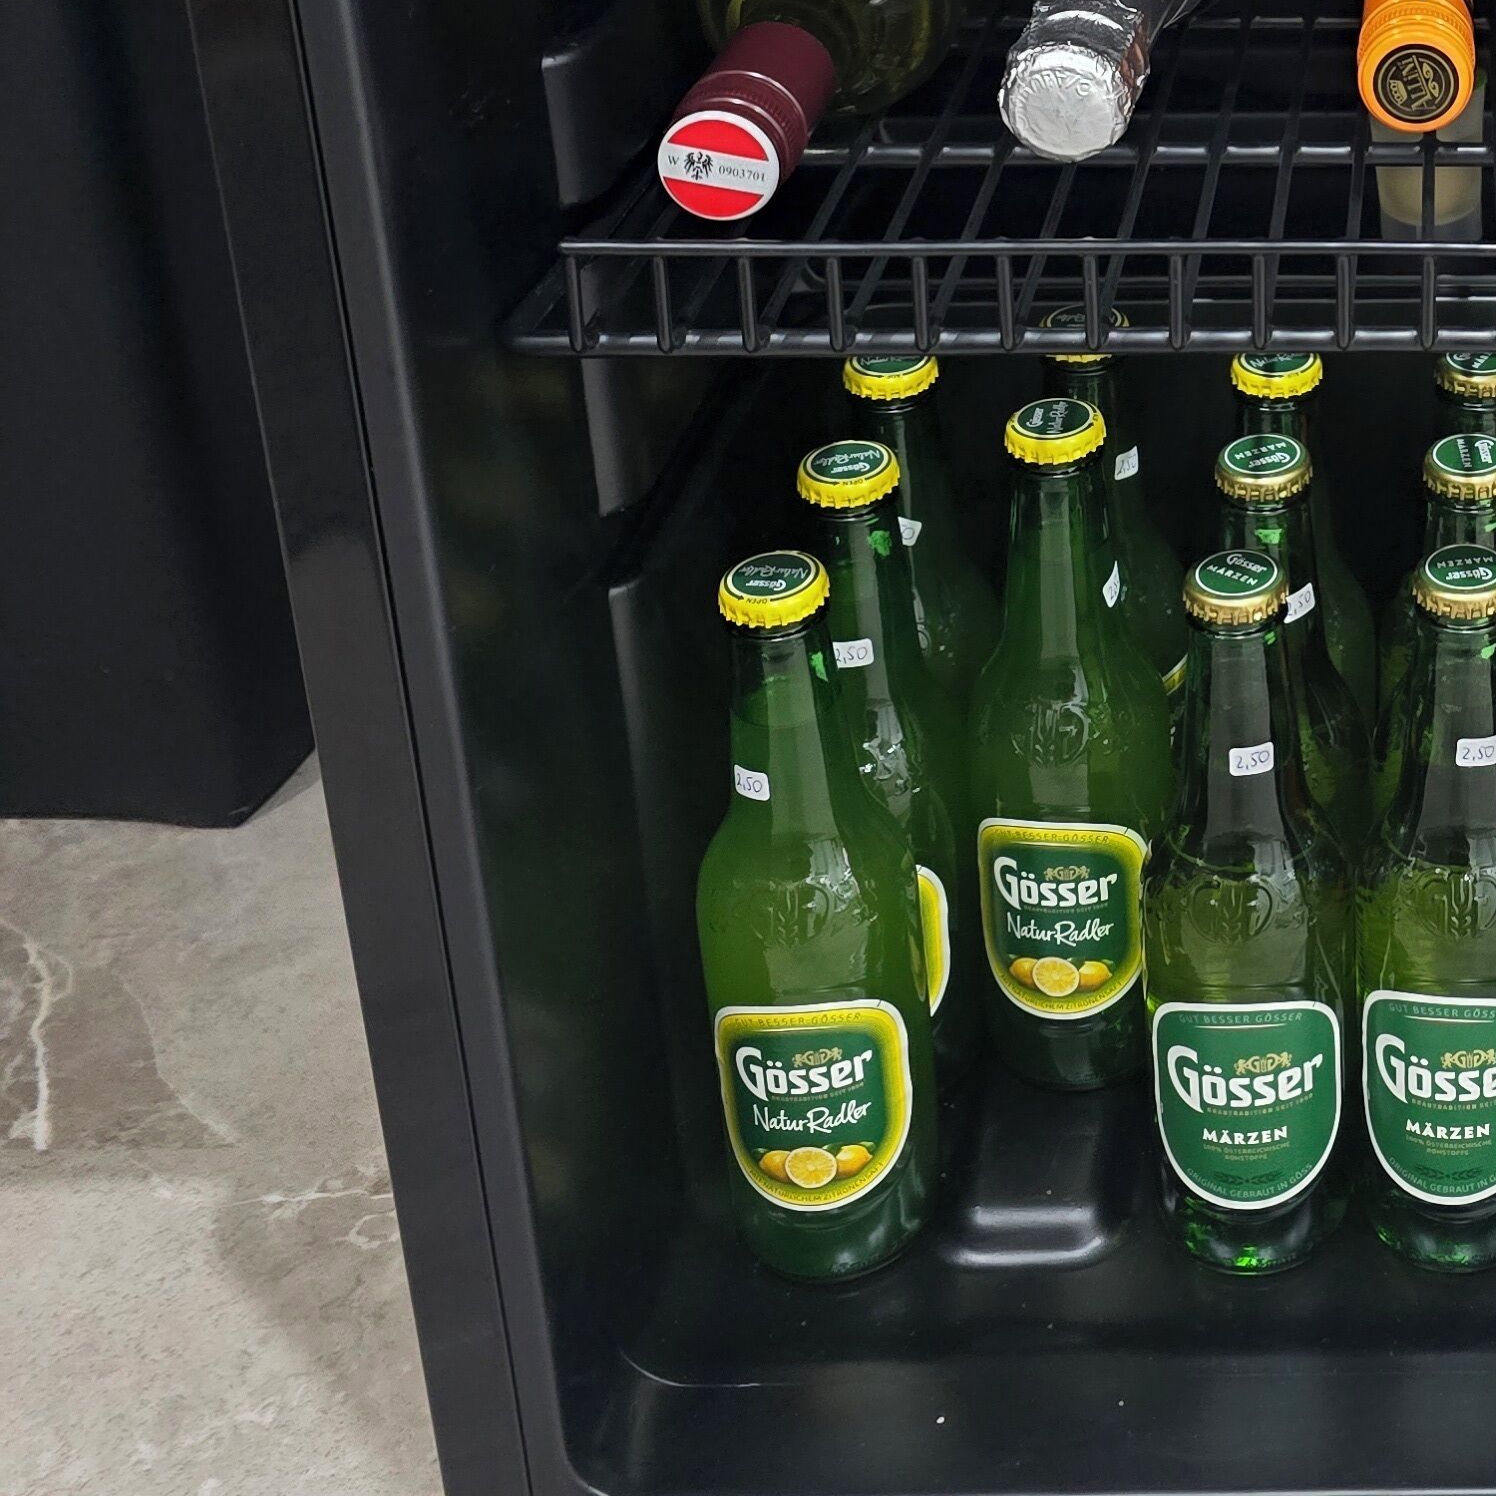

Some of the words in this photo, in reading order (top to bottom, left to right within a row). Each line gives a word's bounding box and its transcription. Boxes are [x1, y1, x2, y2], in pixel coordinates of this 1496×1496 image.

[667, 153, 681, 167] W
[717, 164, 767, 183] 0903701
[830, 461, 871, 476] Gösser
[1225, 552, 1268, 575] Gösser
[1443, 565, 1494, 581] Gösser
[745, 577, 788, 591] Gösser
[1233, 748, 1272, 772] 2,50
[1462, 743, 1496, 762] 2,50
[993, 856, 1118, 911] Gösser
[1006, 911, 1115, 947] NaturRadler
[1203, 1014, 1251, 1025] BESSER
[1255, 1011, 1304, 1024] GÖSSER
[1412, 1005, 1459, 1018] BESSER
[735, 1045, 873, 1102] Gösser
[1167, 1044, 1323, 1114] Gösser
[752, 1099, 873, 1134] NaturRadler
[1202, 1125, 1289, 1146] MÄRZEN
[1405, 1118, 1491, 1141] MÄRZEN
[1186, 1166, 1228, 1196] ORIGINAL
[1229, 1186, 1278, 1199] GEBRAUT
[1277, 1180, 1289, 1192] IN
[1388, 1155, 1428, 1191] ORIGINAL
[1429, 1182, 1477, 1195] GEBRAUT
[1477, 1178, 1490, 1190] IN
